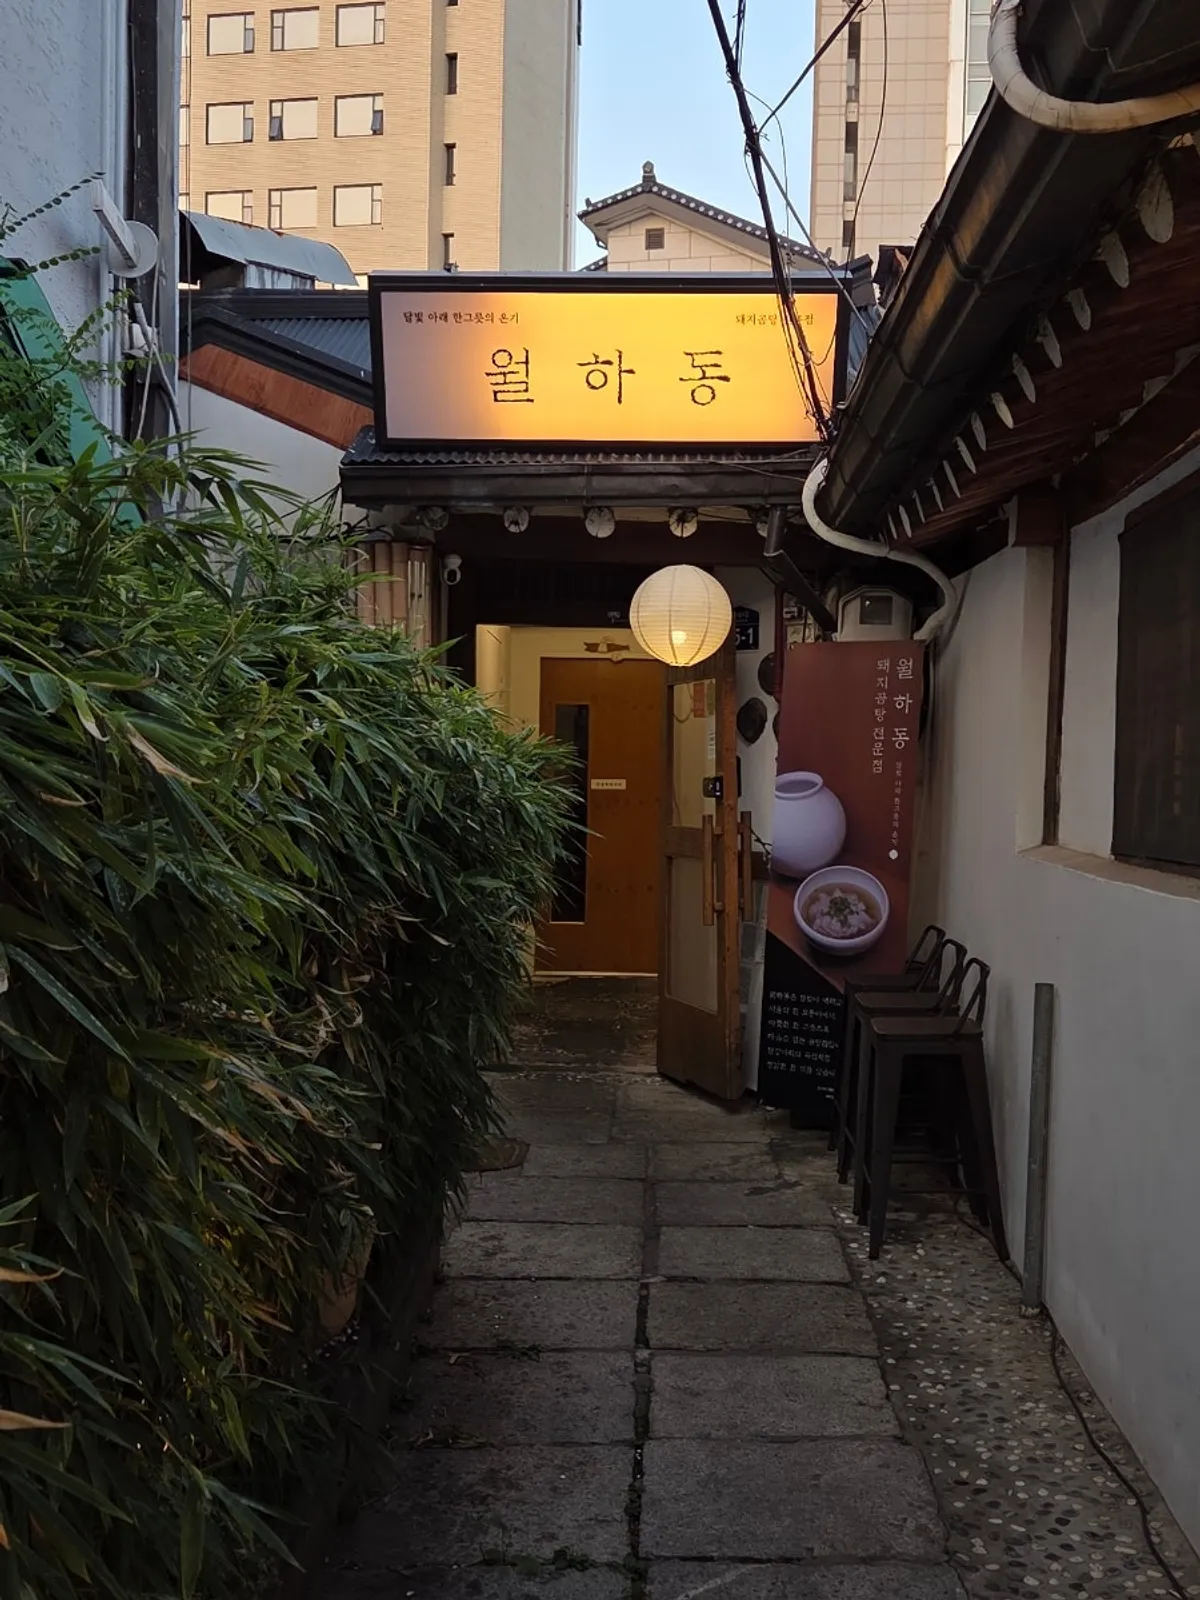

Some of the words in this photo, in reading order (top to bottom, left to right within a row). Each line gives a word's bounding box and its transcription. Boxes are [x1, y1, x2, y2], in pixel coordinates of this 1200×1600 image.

[403, 311, 424, 324] 달빛
[428, 311, 448, 324] 아래
[453, 311, 495, 324] 한그릇의
[498, 312, 519, 324] 온기
[735, 313, 778, 326] 돼지곰탕
[484, 347, 731, 406] 월하동
[873, 657, 890, 723] 돼지곰탕
[891, 656, 914, 751] 월하동
[872, 726, 885, 775] 전문점
